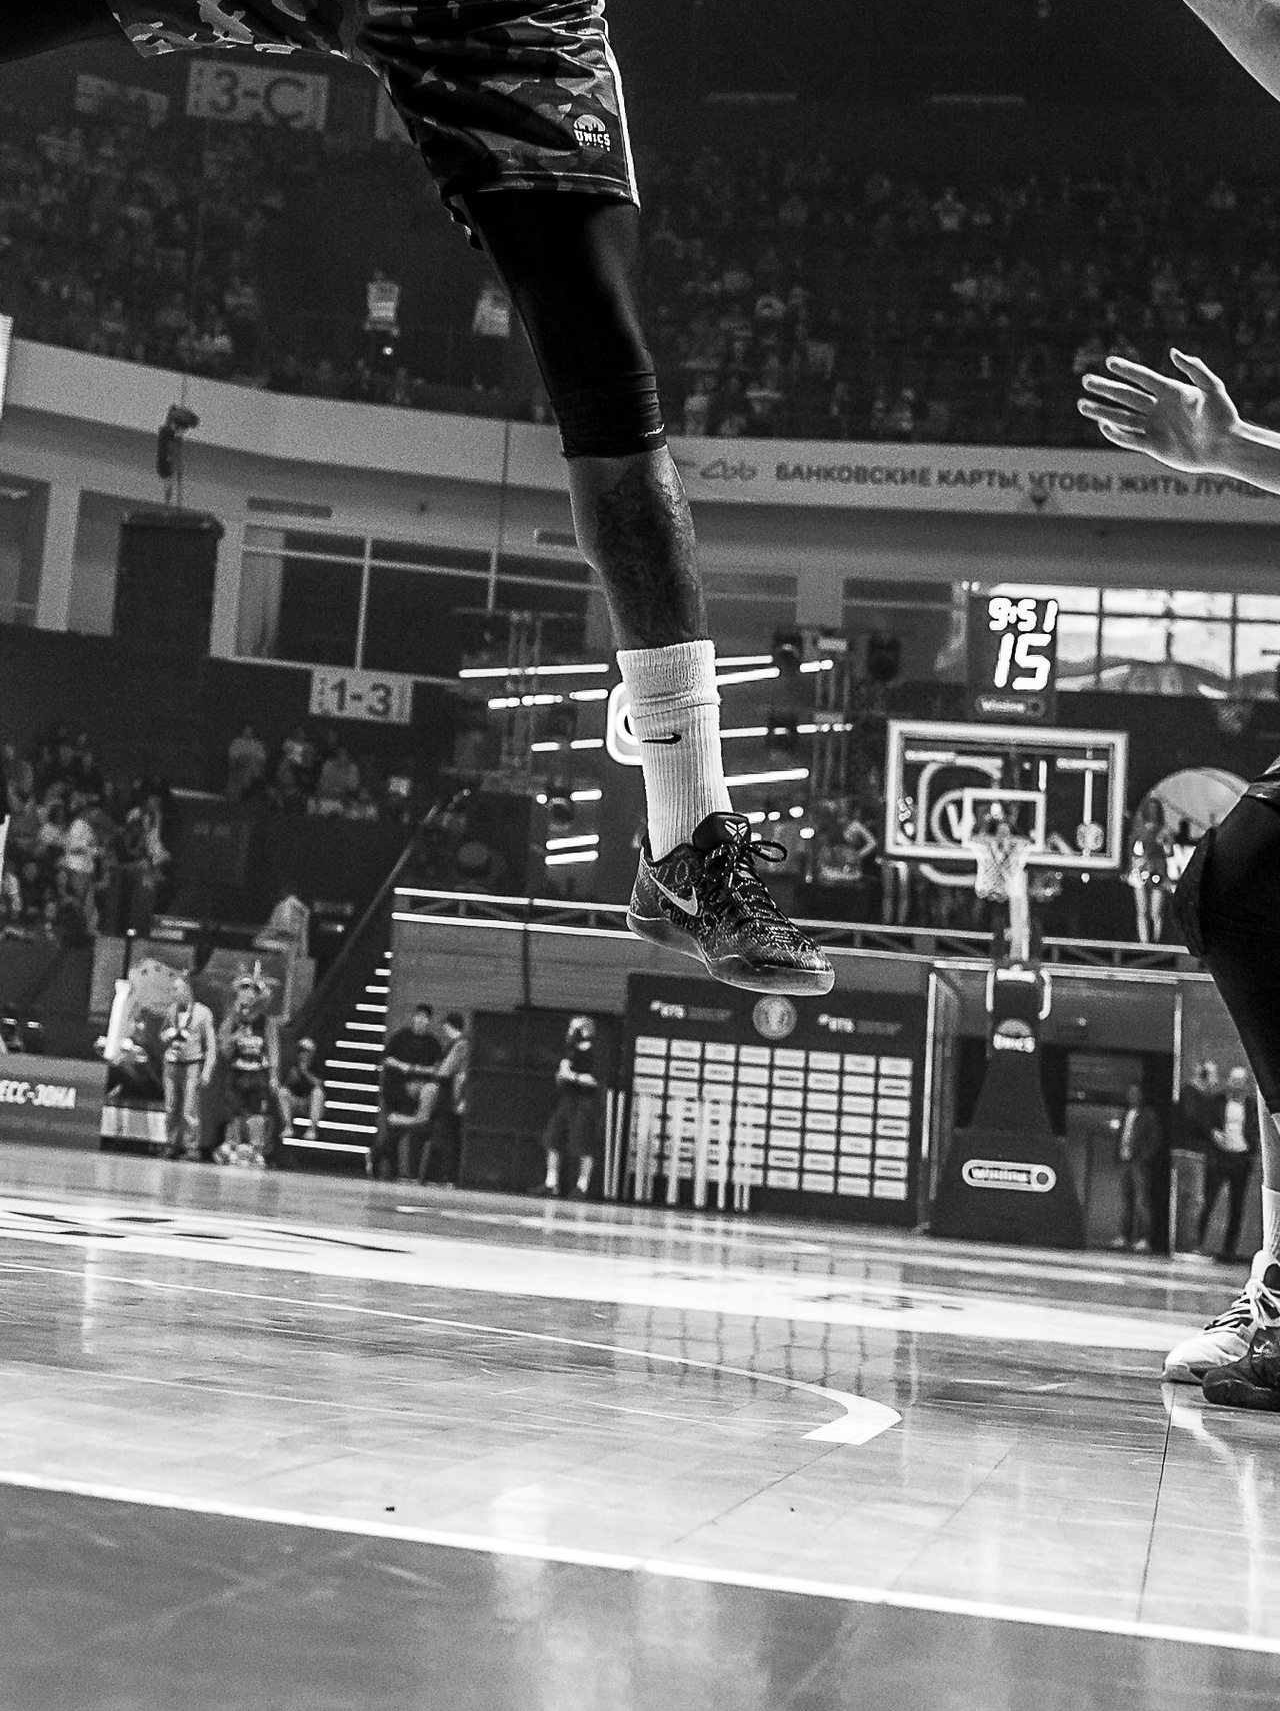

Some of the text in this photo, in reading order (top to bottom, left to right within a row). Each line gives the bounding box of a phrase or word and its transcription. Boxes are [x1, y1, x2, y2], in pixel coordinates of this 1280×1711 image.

[573, 129, 611, 147] UNICS
[775, 461, 931, 488] БАНКОВСКИЕ
[1029, 472, 1111, 493] ЧТОБЫ
[1120, 475, 1187, 496] ЖИТЬ
[987, 597, 1059, 633] 9:51
[994, 632, 1052, 691] 15
[329, 683, 393, 718] 1-3
